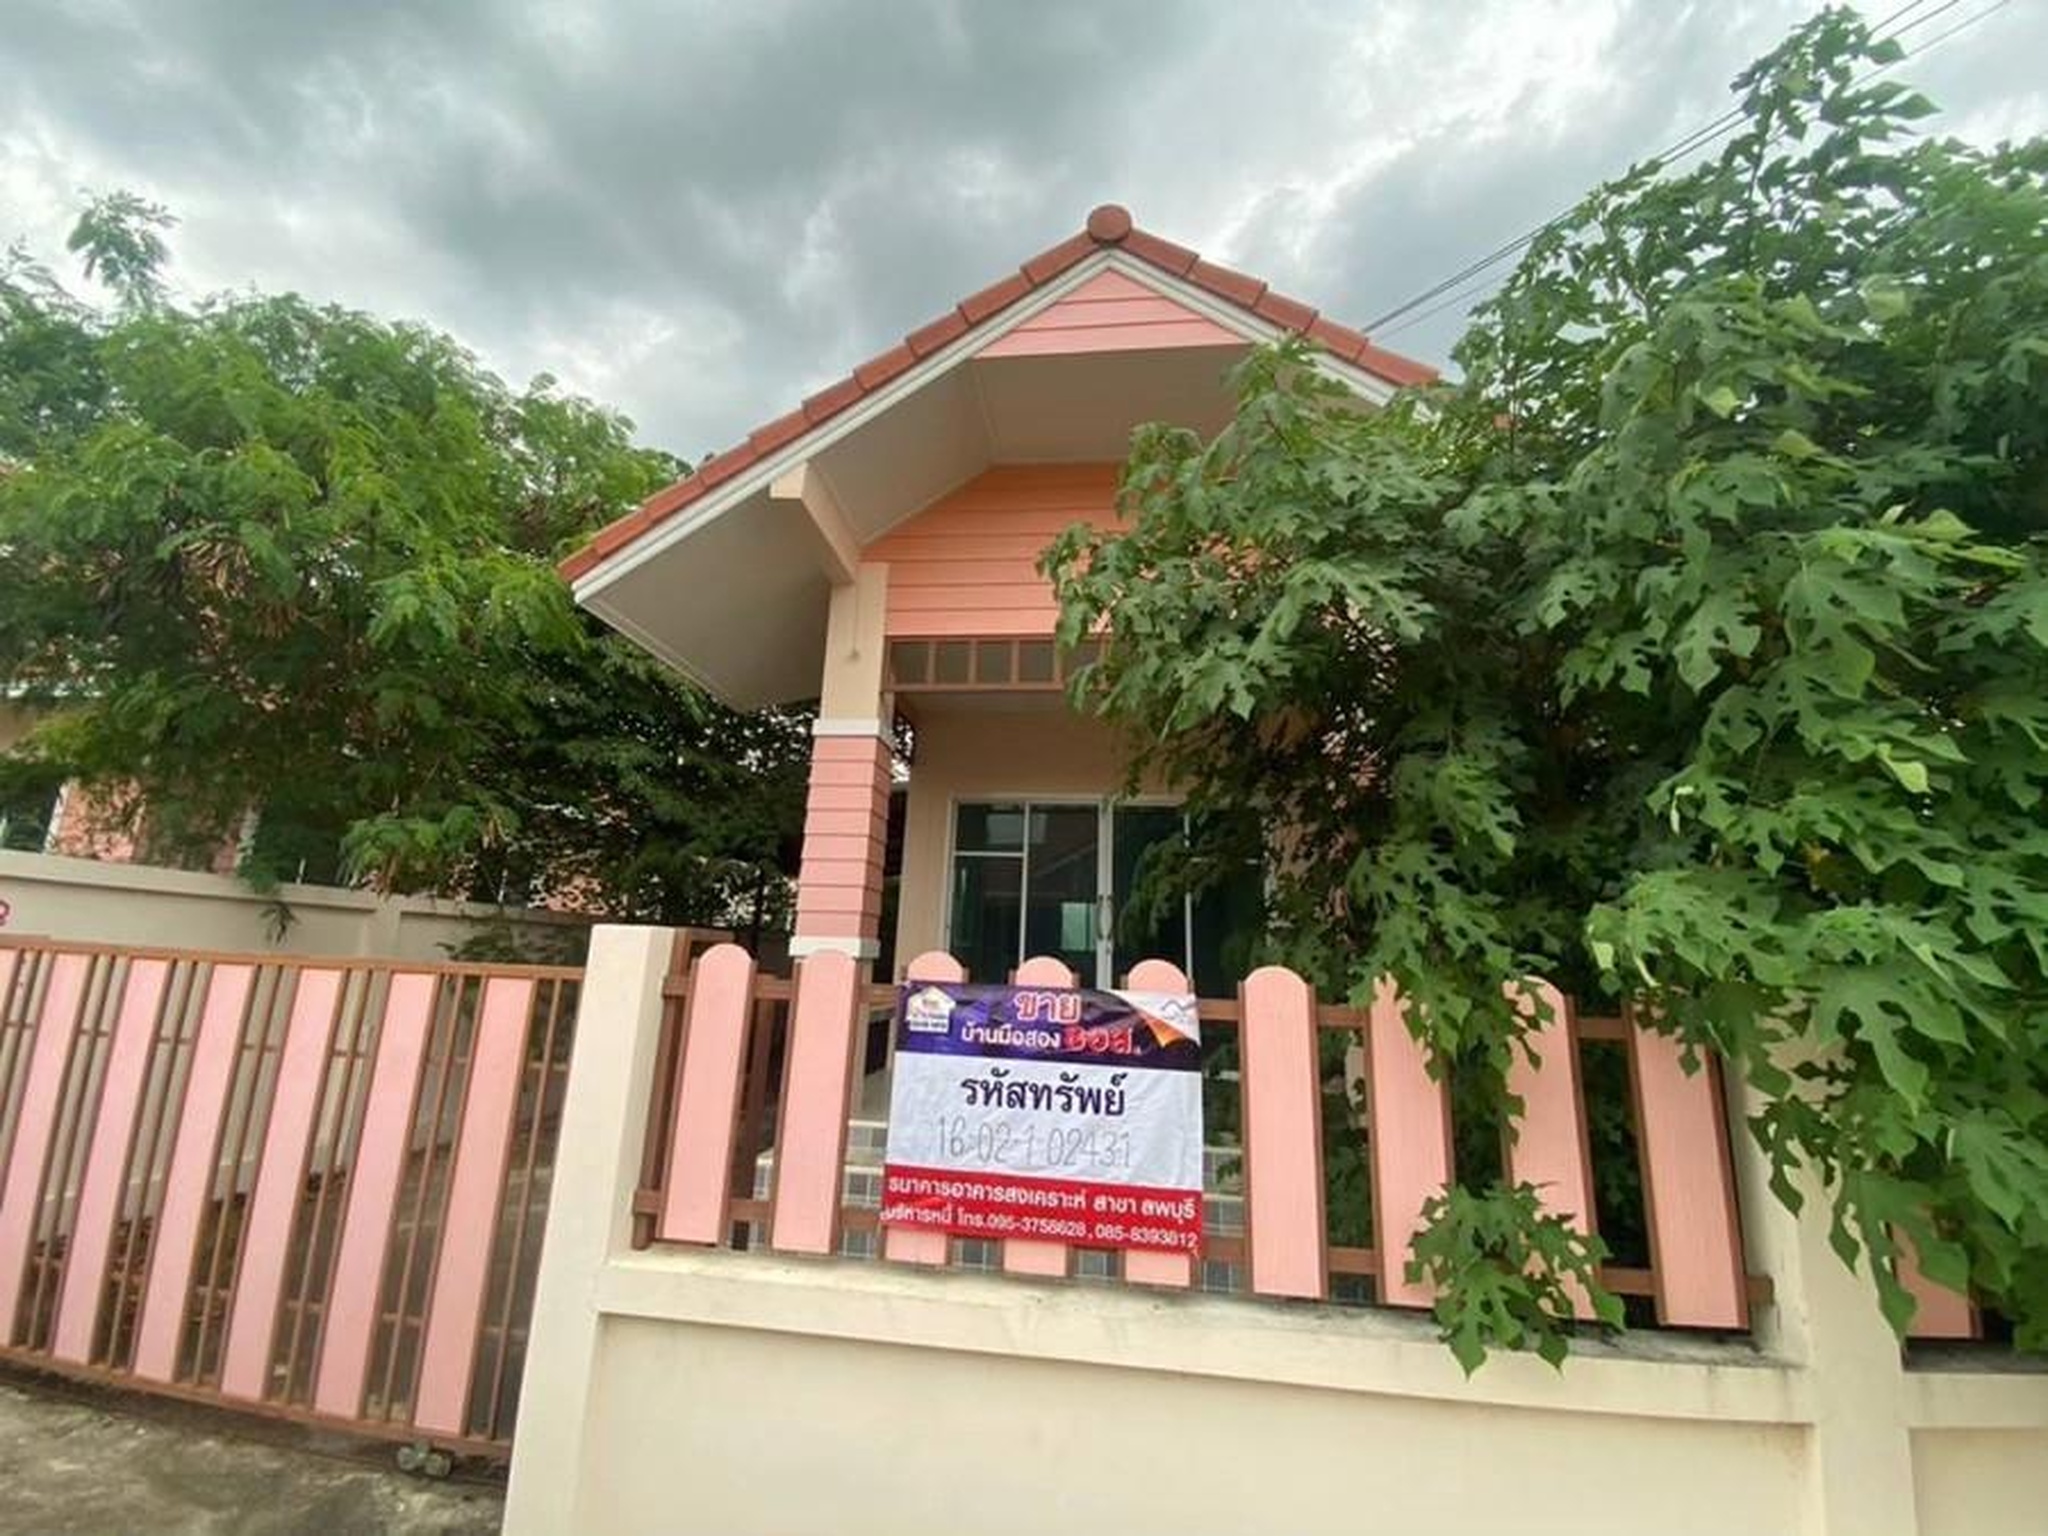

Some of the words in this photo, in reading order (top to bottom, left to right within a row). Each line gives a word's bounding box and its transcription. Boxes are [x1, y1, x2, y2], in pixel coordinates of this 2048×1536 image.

[1015, 990, 1081, 1023] ขาย
[961, 1020, 1061, 1048] บ้านมือสอง
[961, 1066, 1128, 1116] รหัสทรัพย์
[888, 1177, 1087, 1211] ธนาคารอาคารสงเคราะห์
[1093, 1194, 1137, 1213] สาขา
[1141, 1198, 1196, 1225] ลพบุรี
